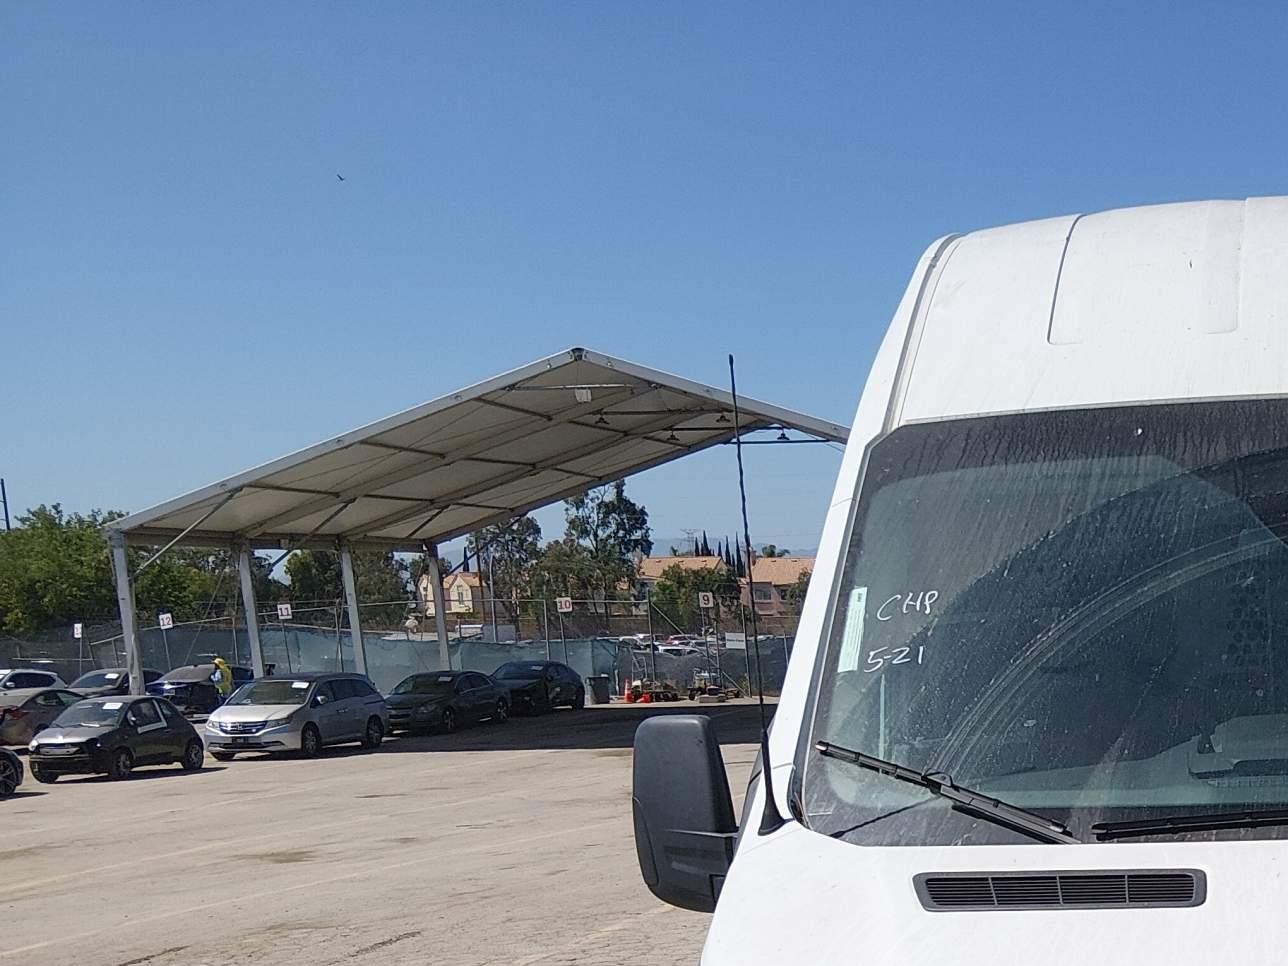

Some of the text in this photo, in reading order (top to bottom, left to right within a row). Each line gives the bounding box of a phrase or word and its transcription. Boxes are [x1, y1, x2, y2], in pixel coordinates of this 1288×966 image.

[558, 600, 571, 610] 10
[702, 594, 710, 605] 9
[161, 616, 172, 627] 12
[863, 646, 924, 673] 5-21
